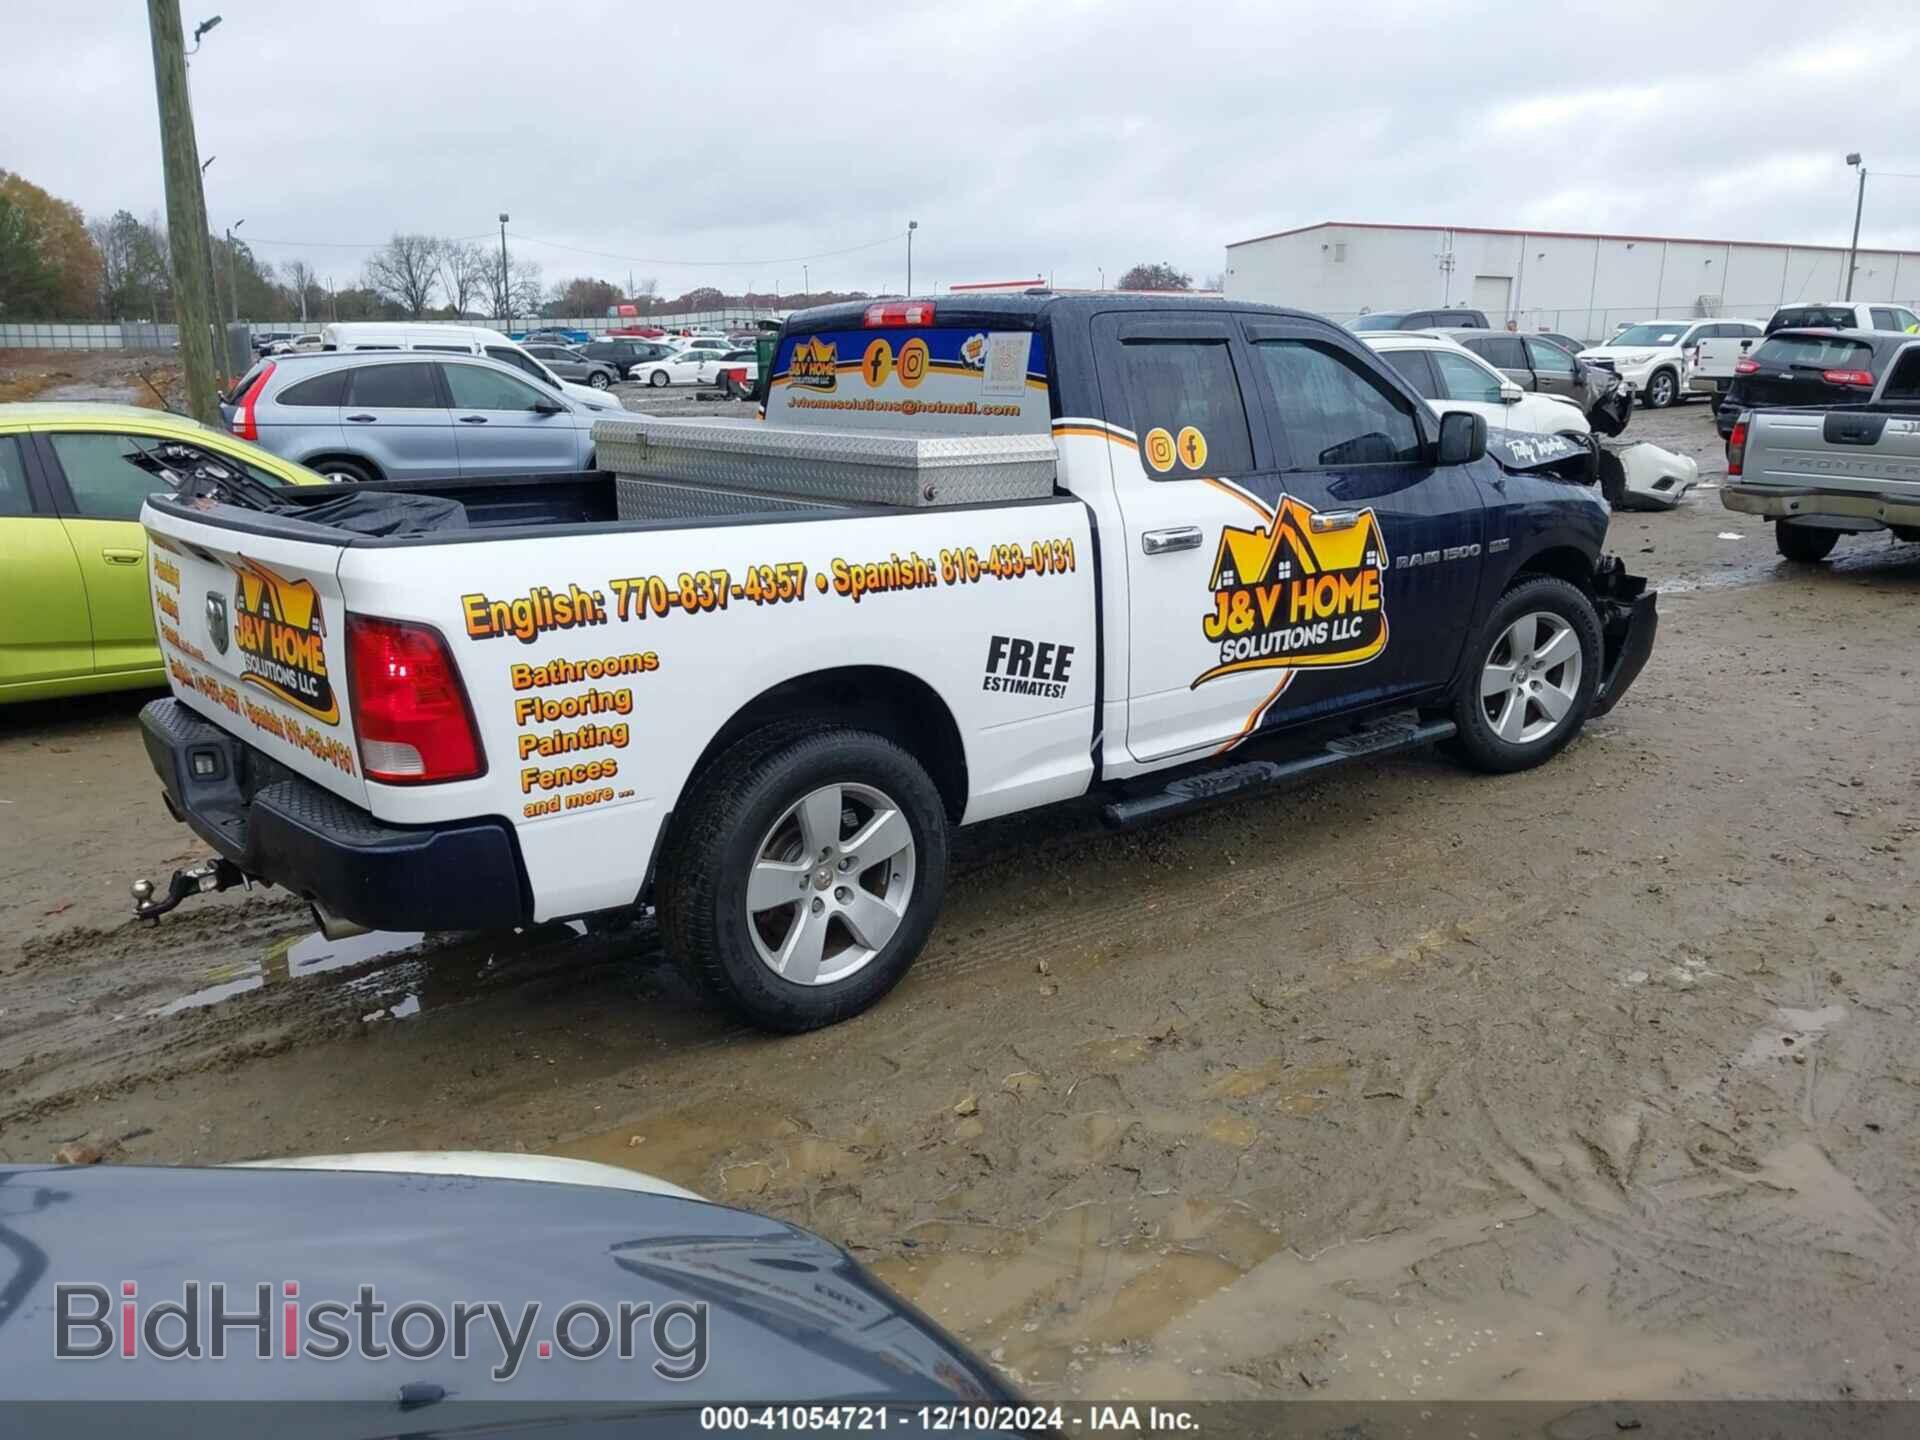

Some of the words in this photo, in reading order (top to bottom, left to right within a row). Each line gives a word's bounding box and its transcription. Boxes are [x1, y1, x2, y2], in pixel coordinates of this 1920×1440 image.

[1780, 456, 1920, 474] FRONTIER
[1395, 550, 1441, 569] RAM
[1442, 543, 1481, 560] 1500
[461, 584, 608, 644] English:
[609, 562, 807, 624] 770-837-4357
[831, 552, 938, 603] Spanish:
[938, 538, 1076, 583] 816-433-0131
[1203, 583, 1283, 641] J&V
[1288, 568, 1381, 624] HOME
[235, 611, 267, 655] J&V
[269, 618, 326, 677] HOME
[985, 635, 1075, 683] FREE
[1220, 625, 1328, 663] SOLUTIONS
[1331, 616, 1363, 642] LLC
[241, 655, 298, 690] SOLUTIONS
[297, 673, 319, 698] LLC
[511, 650, 660, 691] Bathrooms
[982, 676, 1067, 699] ESTIMATES!
[514, 687, 633, 726] Flooring
[517, 722, 630, 760] Painting
[520, 758, 618, 794] Fences
[523, 795, 561, 819] and
[565, 783, 615, 810] more
